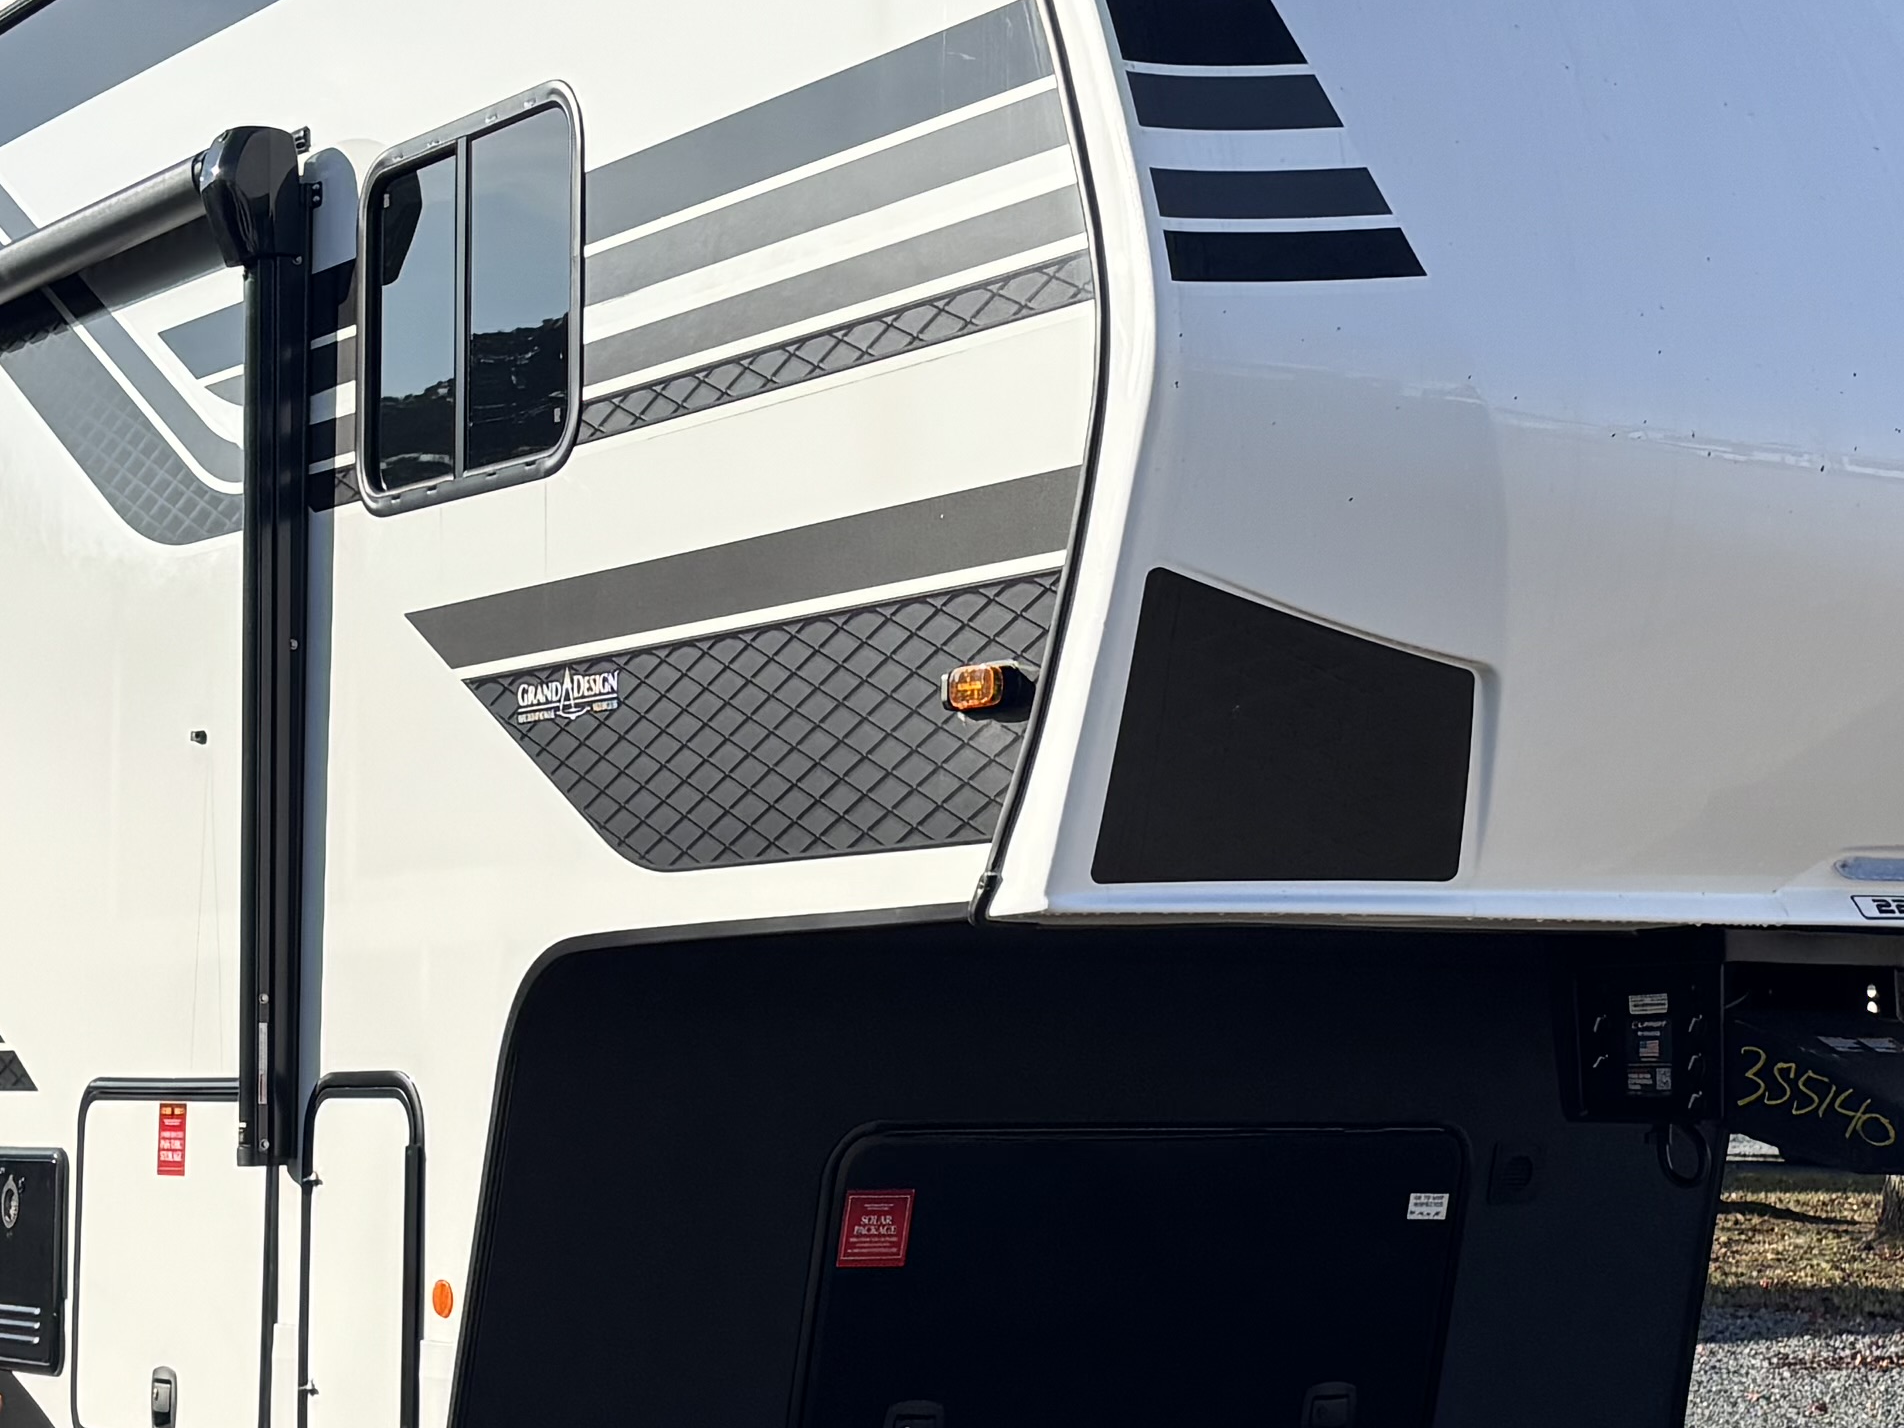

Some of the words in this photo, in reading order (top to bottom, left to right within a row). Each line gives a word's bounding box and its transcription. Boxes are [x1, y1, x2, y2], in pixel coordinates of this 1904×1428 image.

[517, 681, 562, 706] GRAND
[572, 670, 620, 697] DESIGN
[1737, 1046, 1895, 1146] 355140
[853, 1225, 898, 1235] PACKAGE
[860, 1214, 893, 1225] SOLAR
